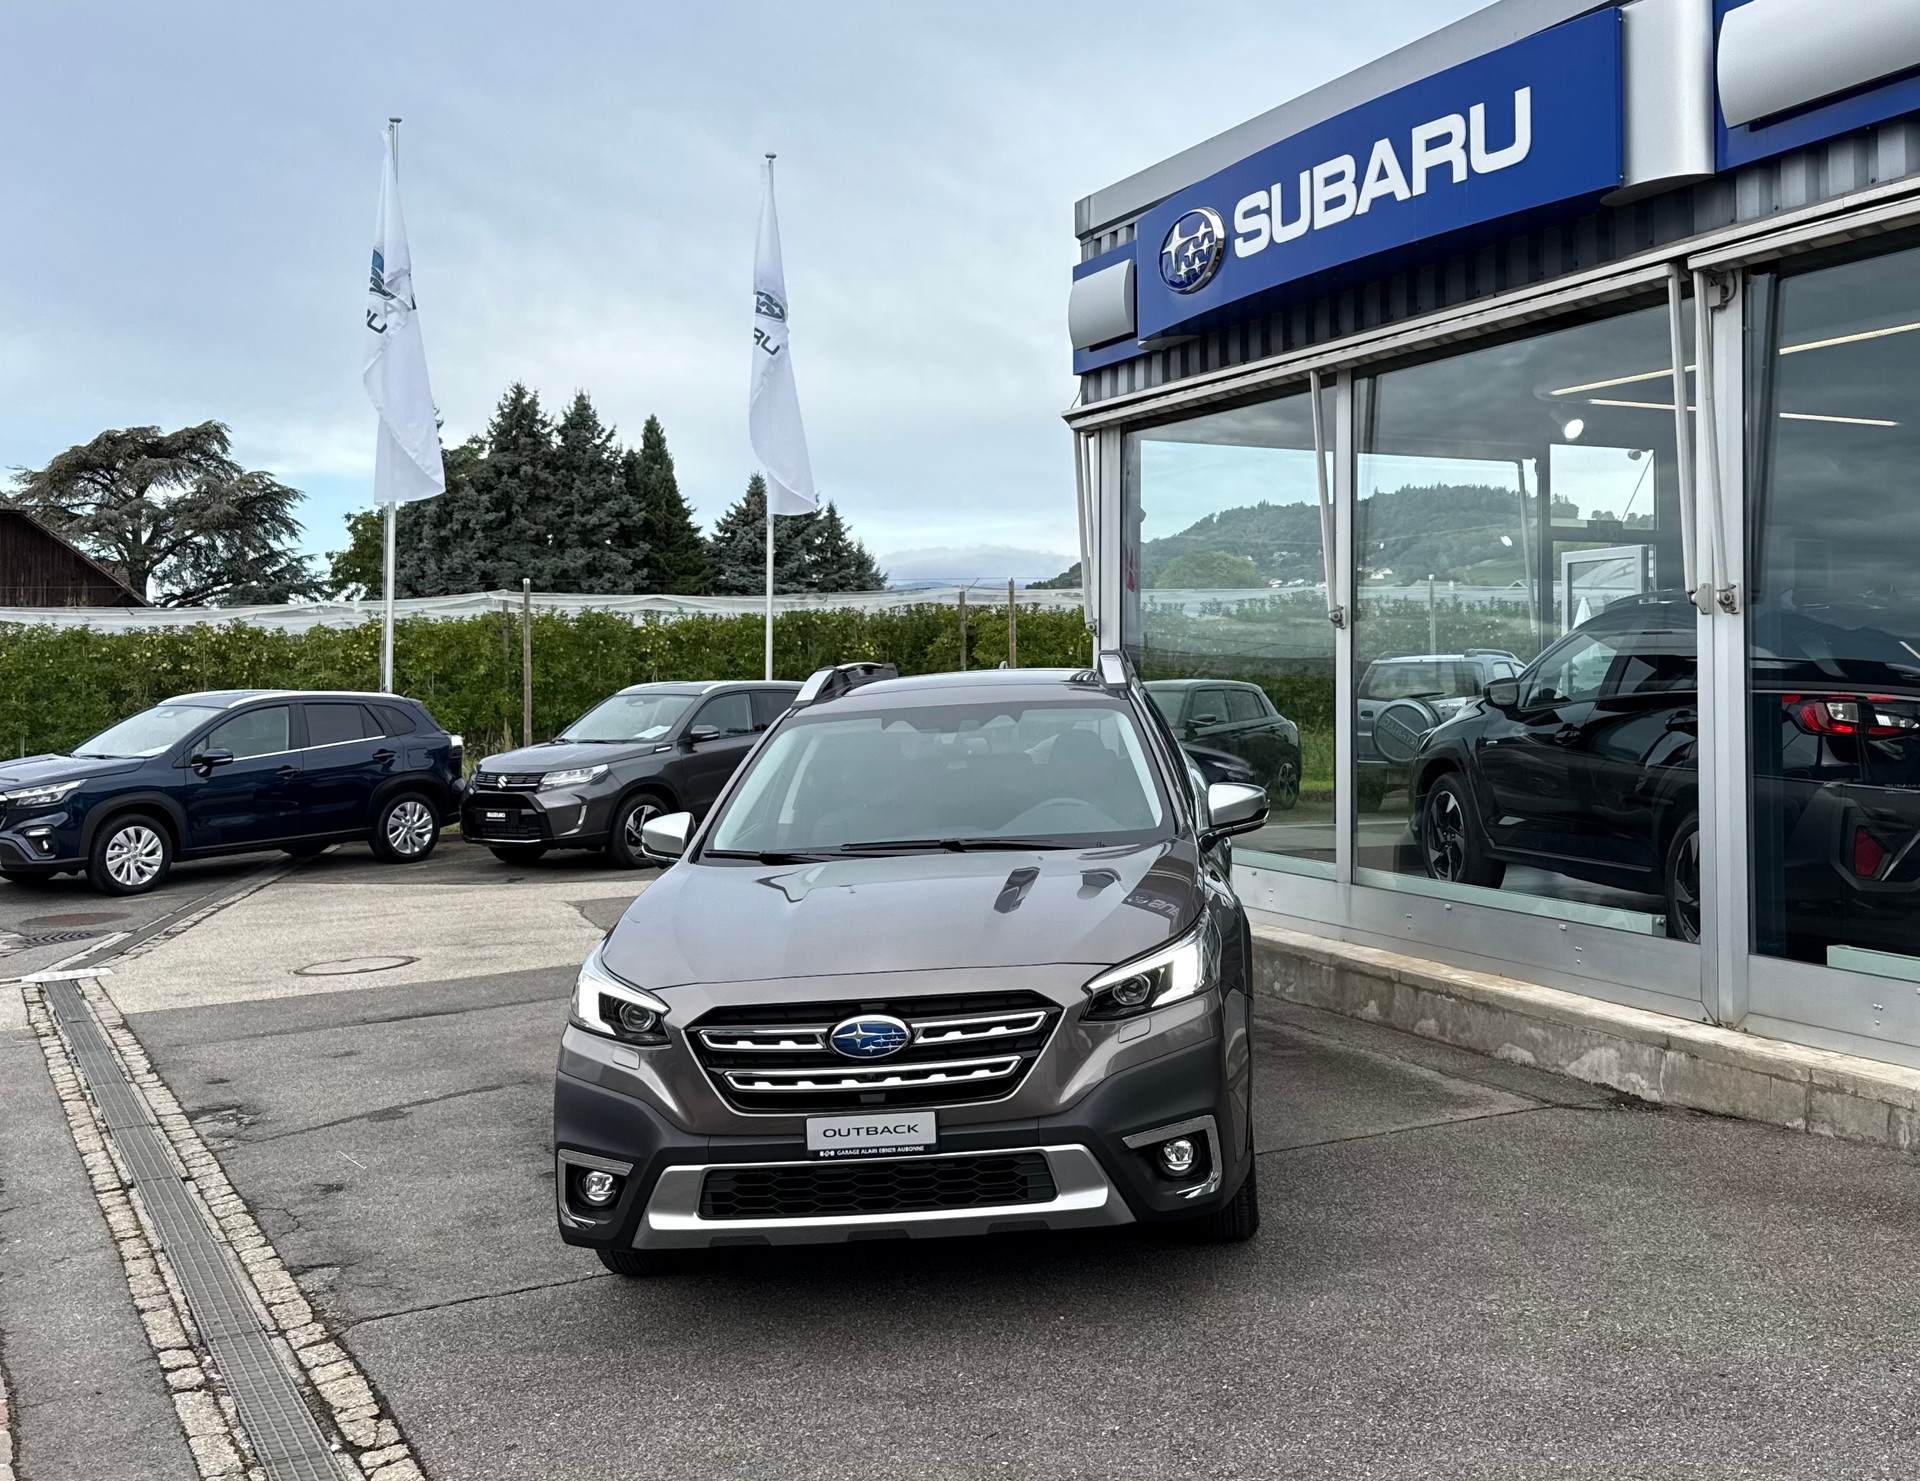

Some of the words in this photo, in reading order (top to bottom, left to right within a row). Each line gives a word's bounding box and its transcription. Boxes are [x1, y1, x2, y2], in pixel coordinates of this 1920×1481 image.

[1233, 86, 1532, 259] SUBARU
[822, 1123, 920, 1138] OUTBACK
[897, 1145, 925, 1153] AUBONNE
